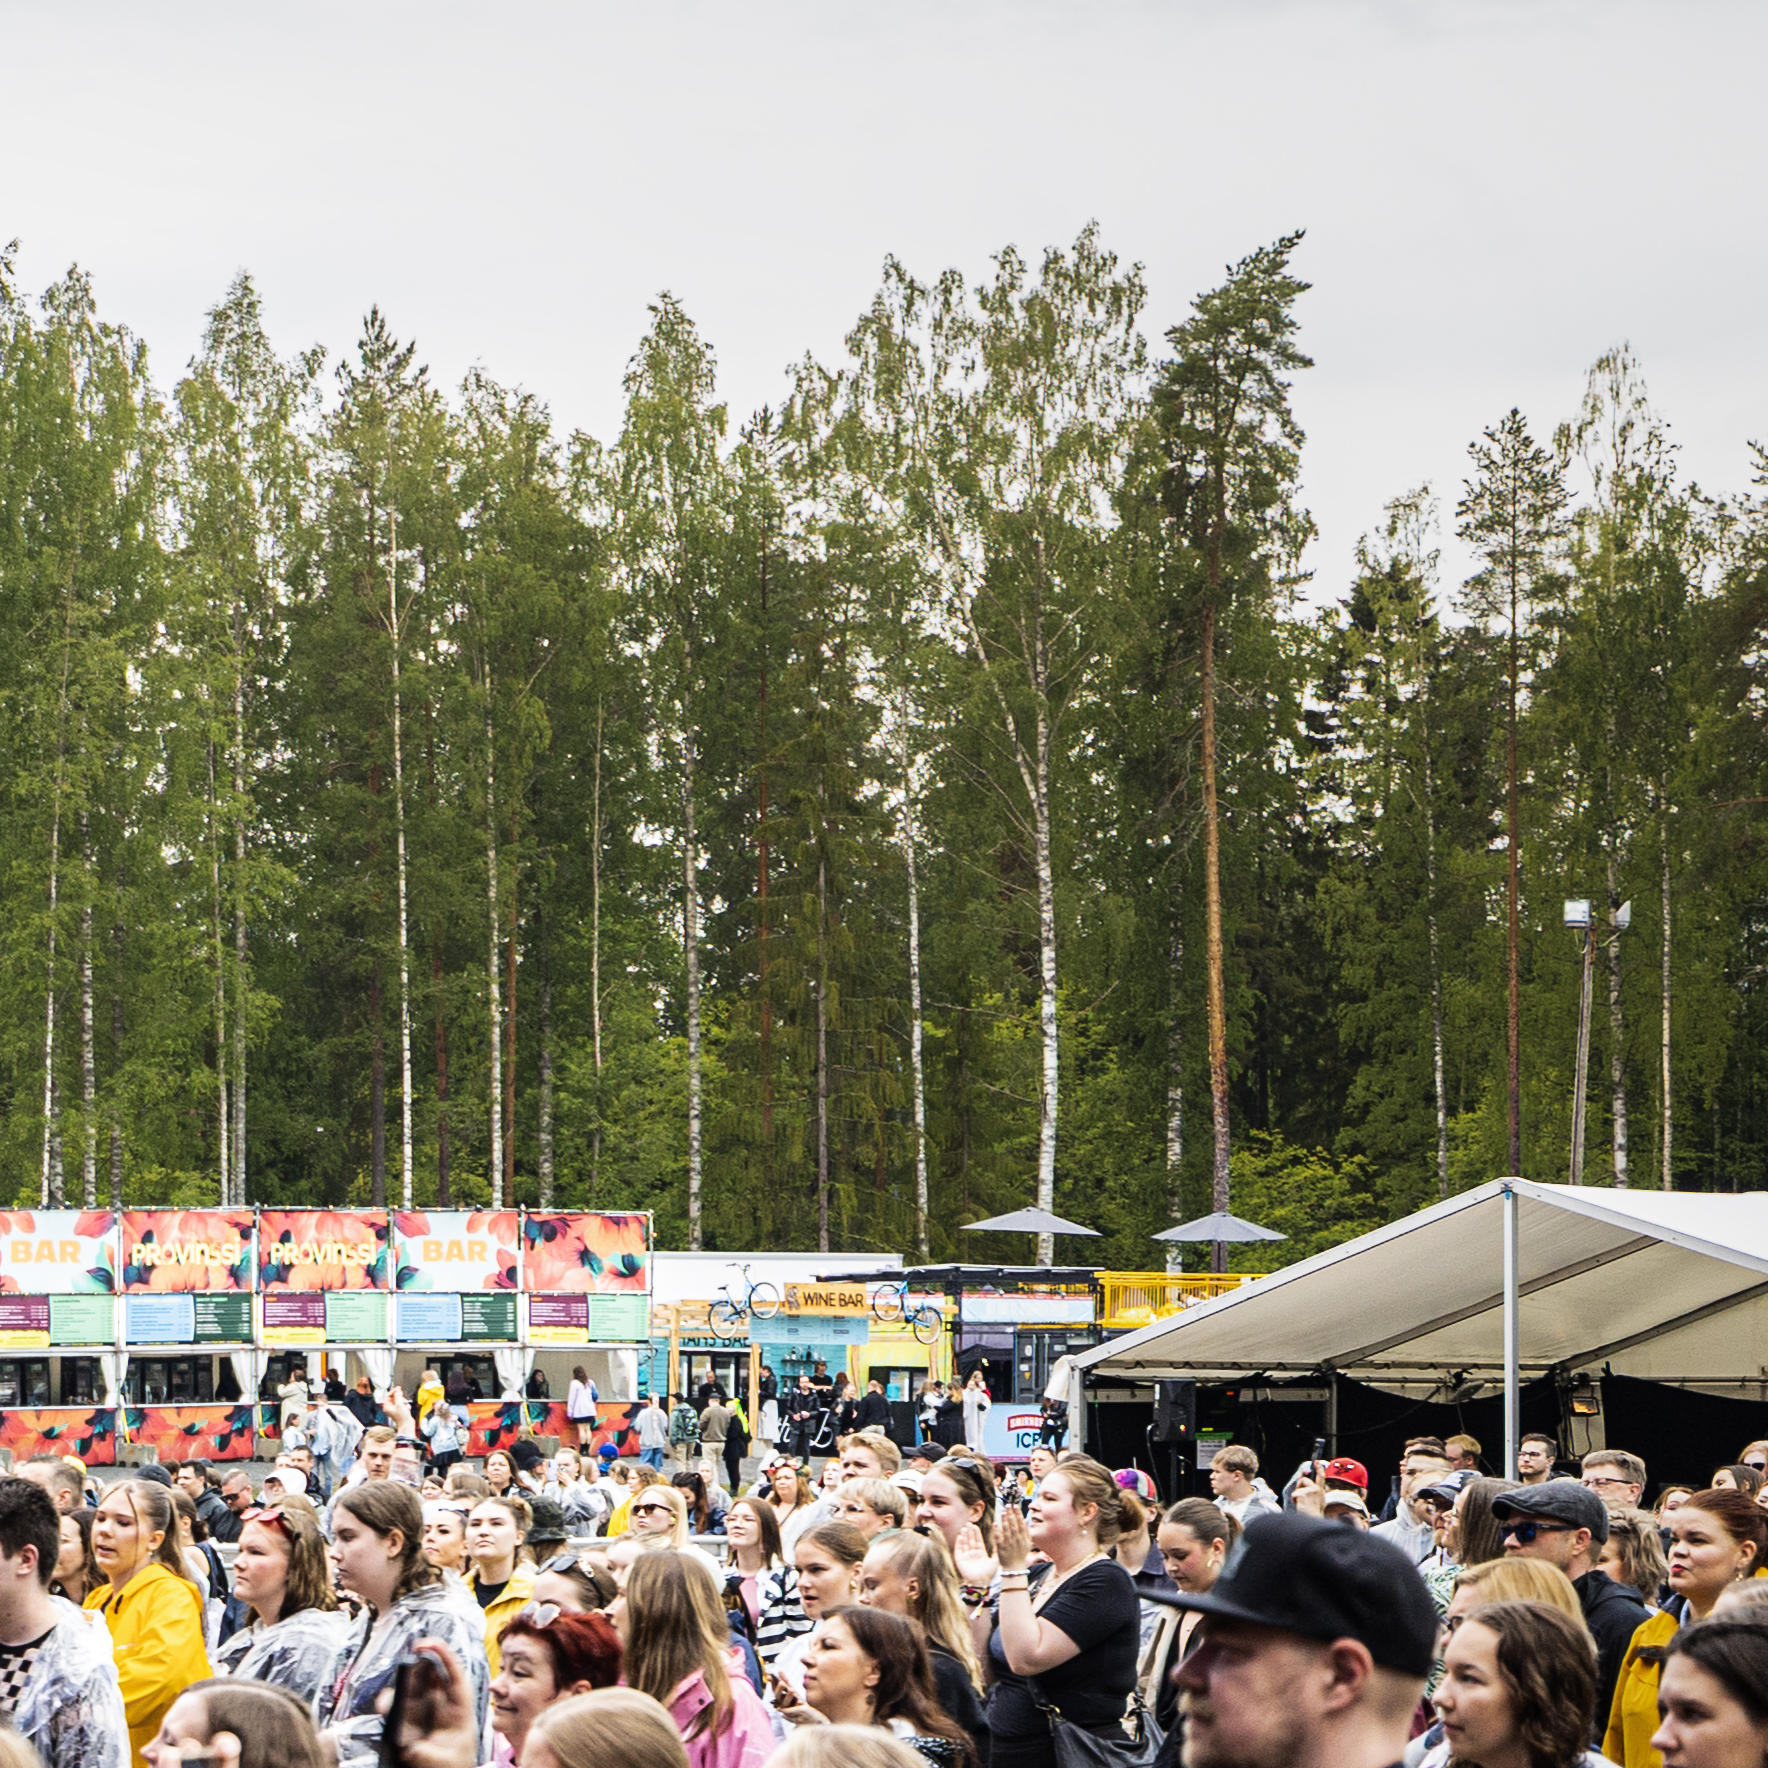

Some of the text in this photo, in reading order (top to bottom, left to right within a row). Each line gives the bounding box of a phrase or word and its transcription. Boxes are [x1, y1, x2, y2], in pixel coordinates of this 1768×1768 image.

[9, 1240, 81, 1264] BAR
[422, 1239, 488, 1263] BAR
[803, 1292, 865, 1309] WINE BAR
